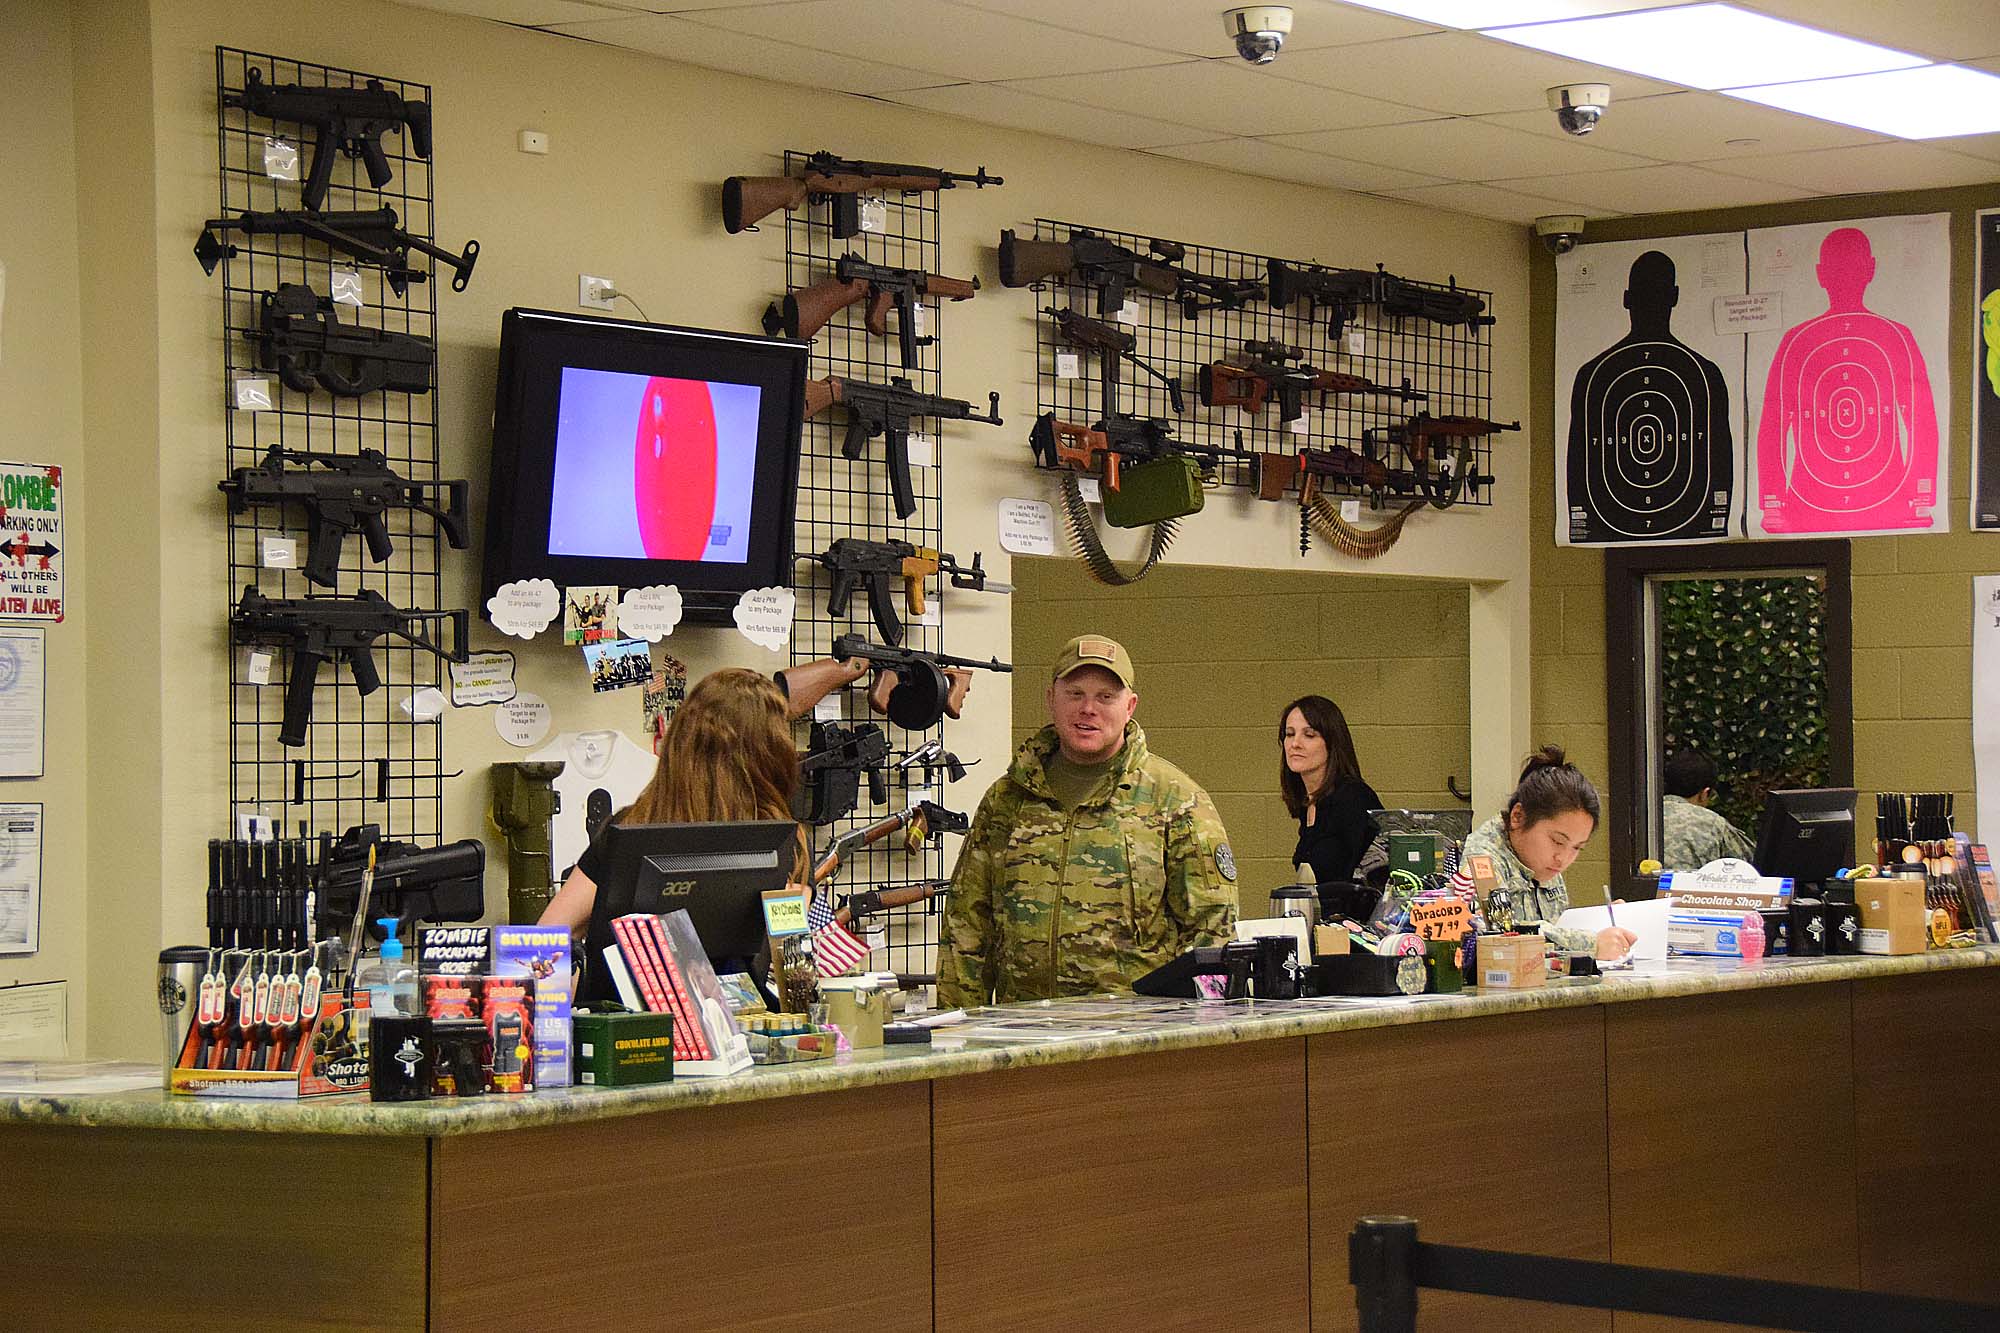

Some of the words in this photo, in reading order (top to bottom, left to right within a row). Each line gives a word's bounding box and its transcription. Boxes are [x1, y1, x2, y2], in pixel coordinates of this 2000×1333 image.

[0, 515, 34, 532] ARKING
[36, 517, 59, 533] ONLY
[2, 571, 18, 580] ALL
[21, 571, 58, 581] OTHERS
[11, 584, 33, 594] WILL
[36, 585, 48, 594] BE
[0, 598, 27, 614] ATEN
[31, 598, 61, 615] ALIVE
[485, 657, 503, 665] pictures
[472, 679, 492, 687] CANNOT
[662, 878, 697, 897] acer
[1681, 893, 1732, 907] Chocolate
[1734, 895, 1763, 910] Shop
[425, 928, 488, 945] ZOMBIE
[500, 932, 569, 947] SKYDIVE
[424, 945, 488, 959] APOCALYPSE
[615, 1037, 651, 1050] CHOCOLATE
[652, 1036, 670, 1047] AMMO
[189, 1079, 224, 1090] Shotgun
